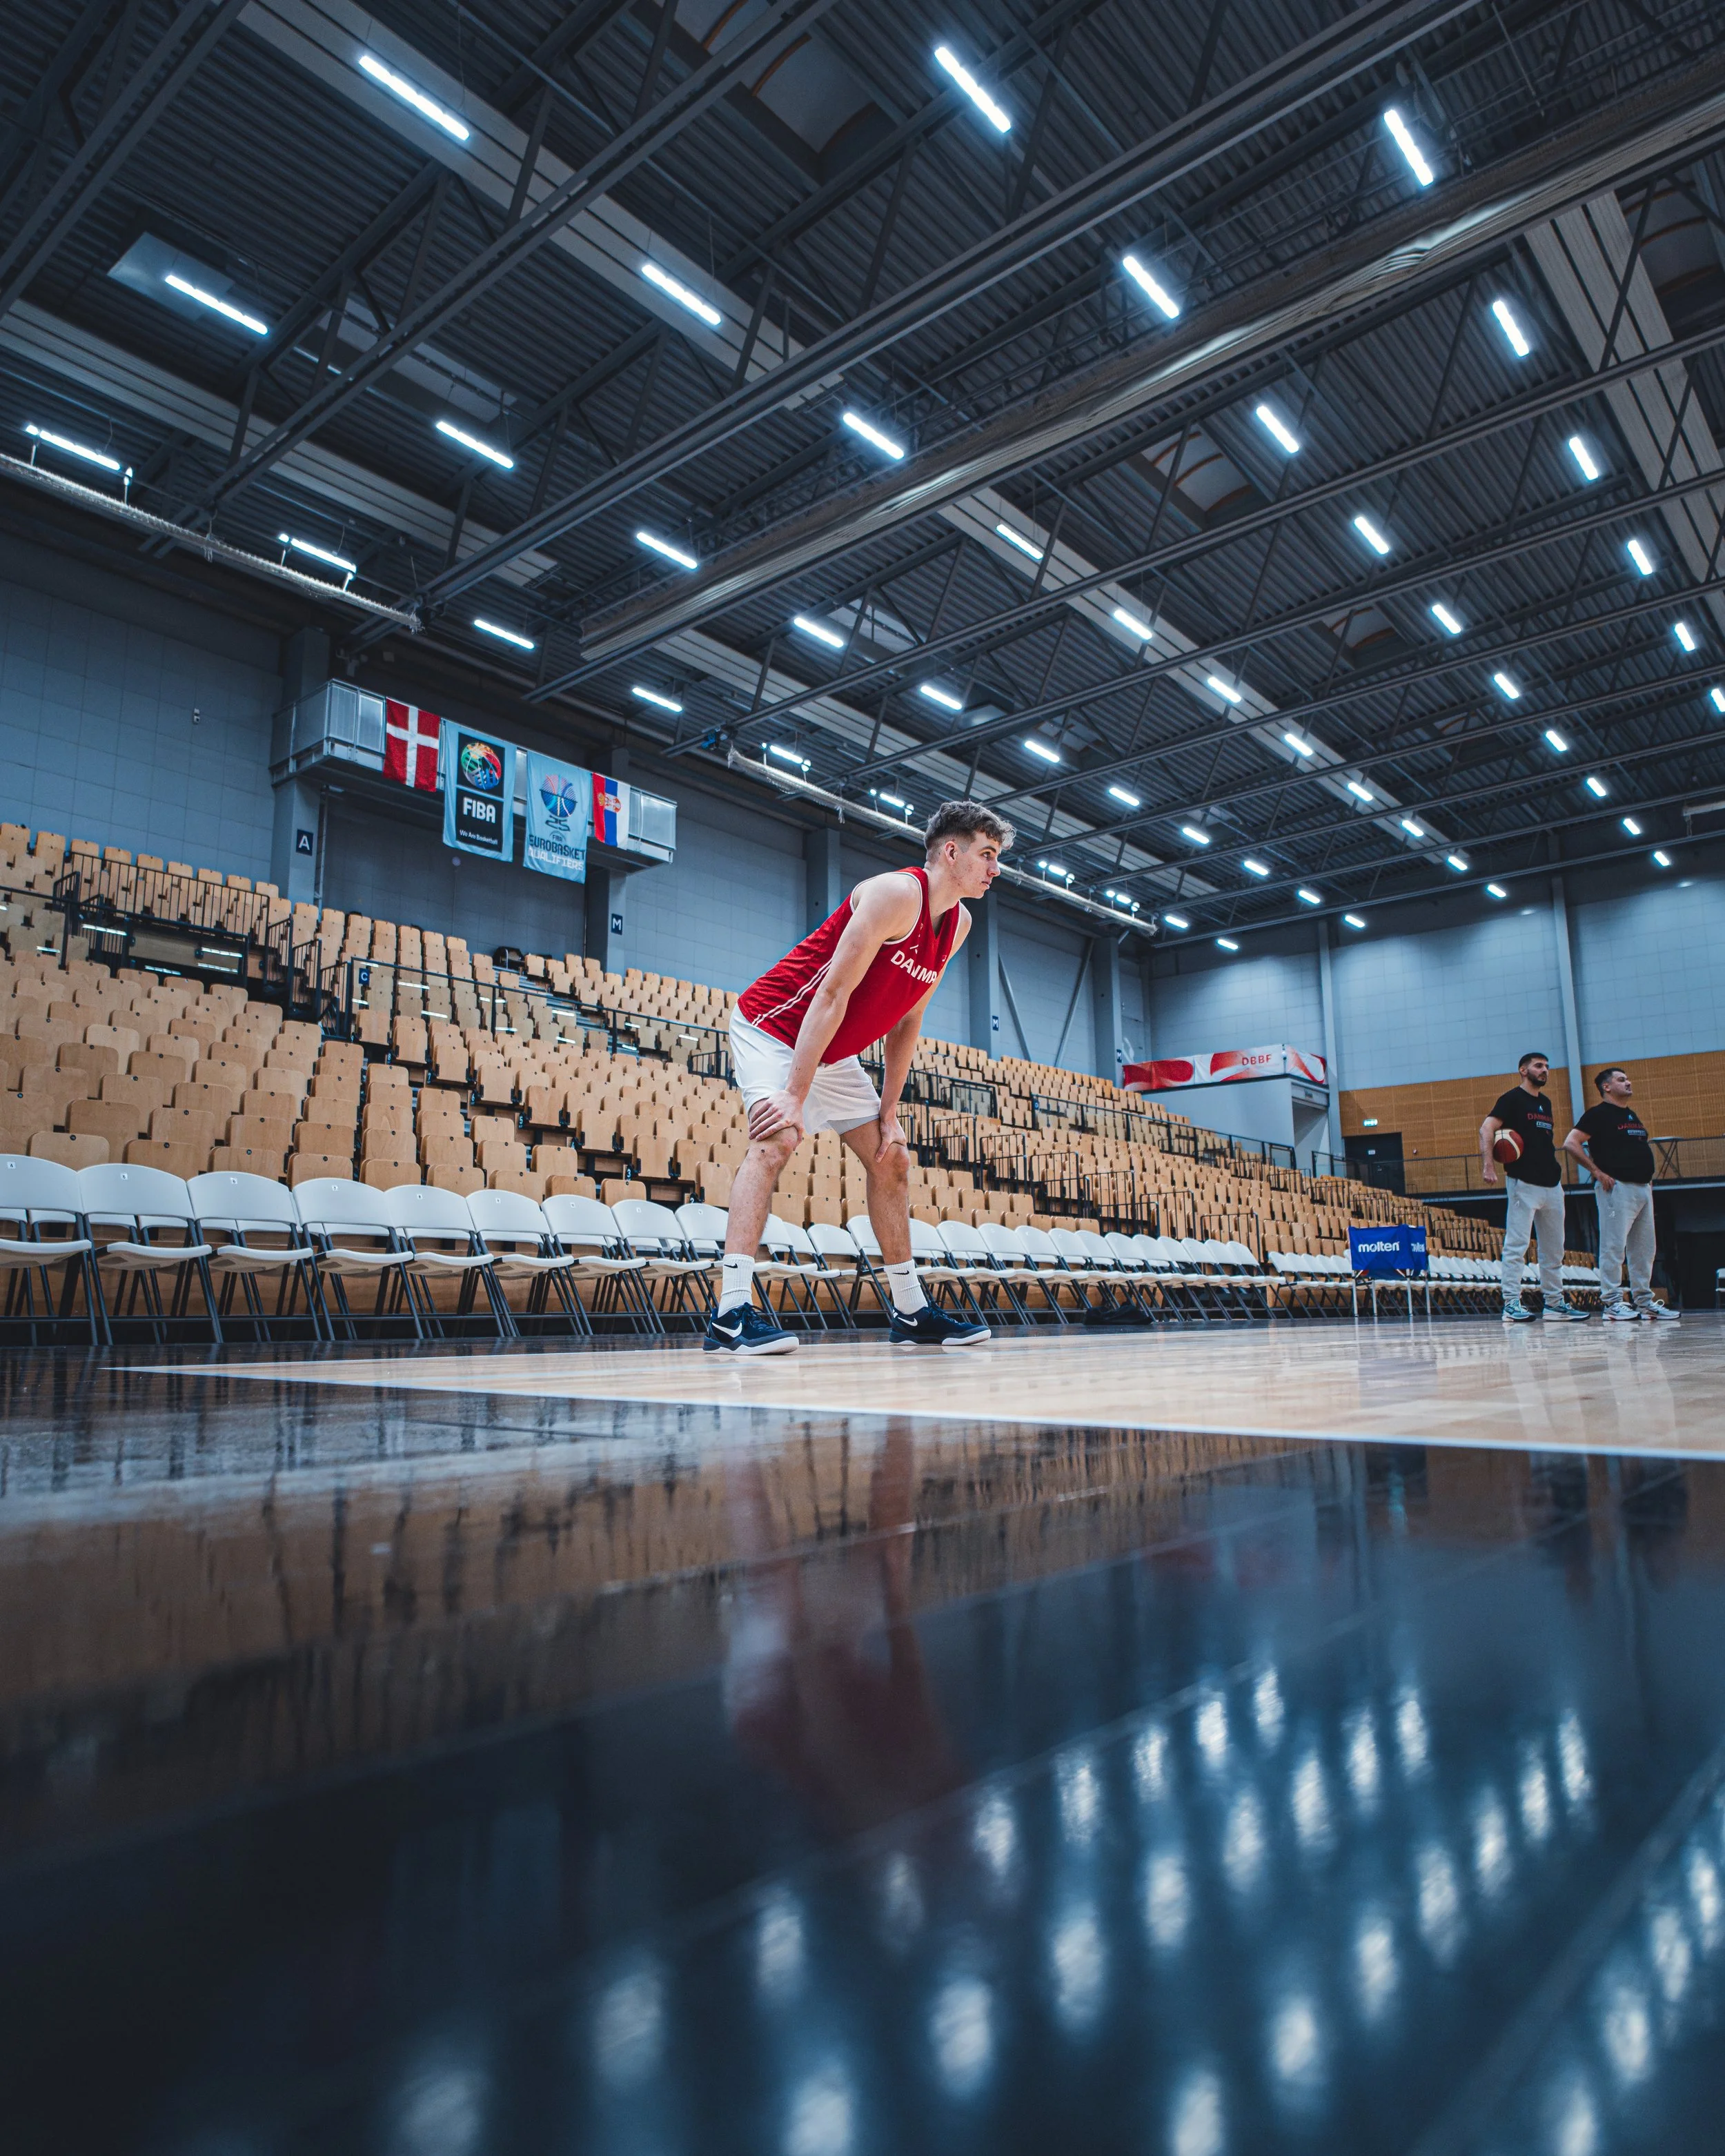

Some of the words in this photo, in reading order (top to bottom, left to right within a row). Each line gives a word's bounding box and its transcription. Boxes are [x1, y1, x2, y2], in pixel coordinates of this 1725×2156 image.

[463, 797, 496, 824] FIBA
[299, 835, 310, 851] A
[476, 833, 497, 845] Basketball
[529, 834, 586, 860] EUROBASKET
[613, 918, 622, 931] M
[361, 972, 368, 981] C
[993, 1018, 998, 1028] M
[388, 1053, 391, 1061] 8
[1242, 1054, 1272, 1066] DBBF
[471, 1093, 475, 1102] 6
[519, 1116, 523, 1125] 5
[627, 1169, 631, 1178] 3
[1358, 1241, 1400, 1253] molten
